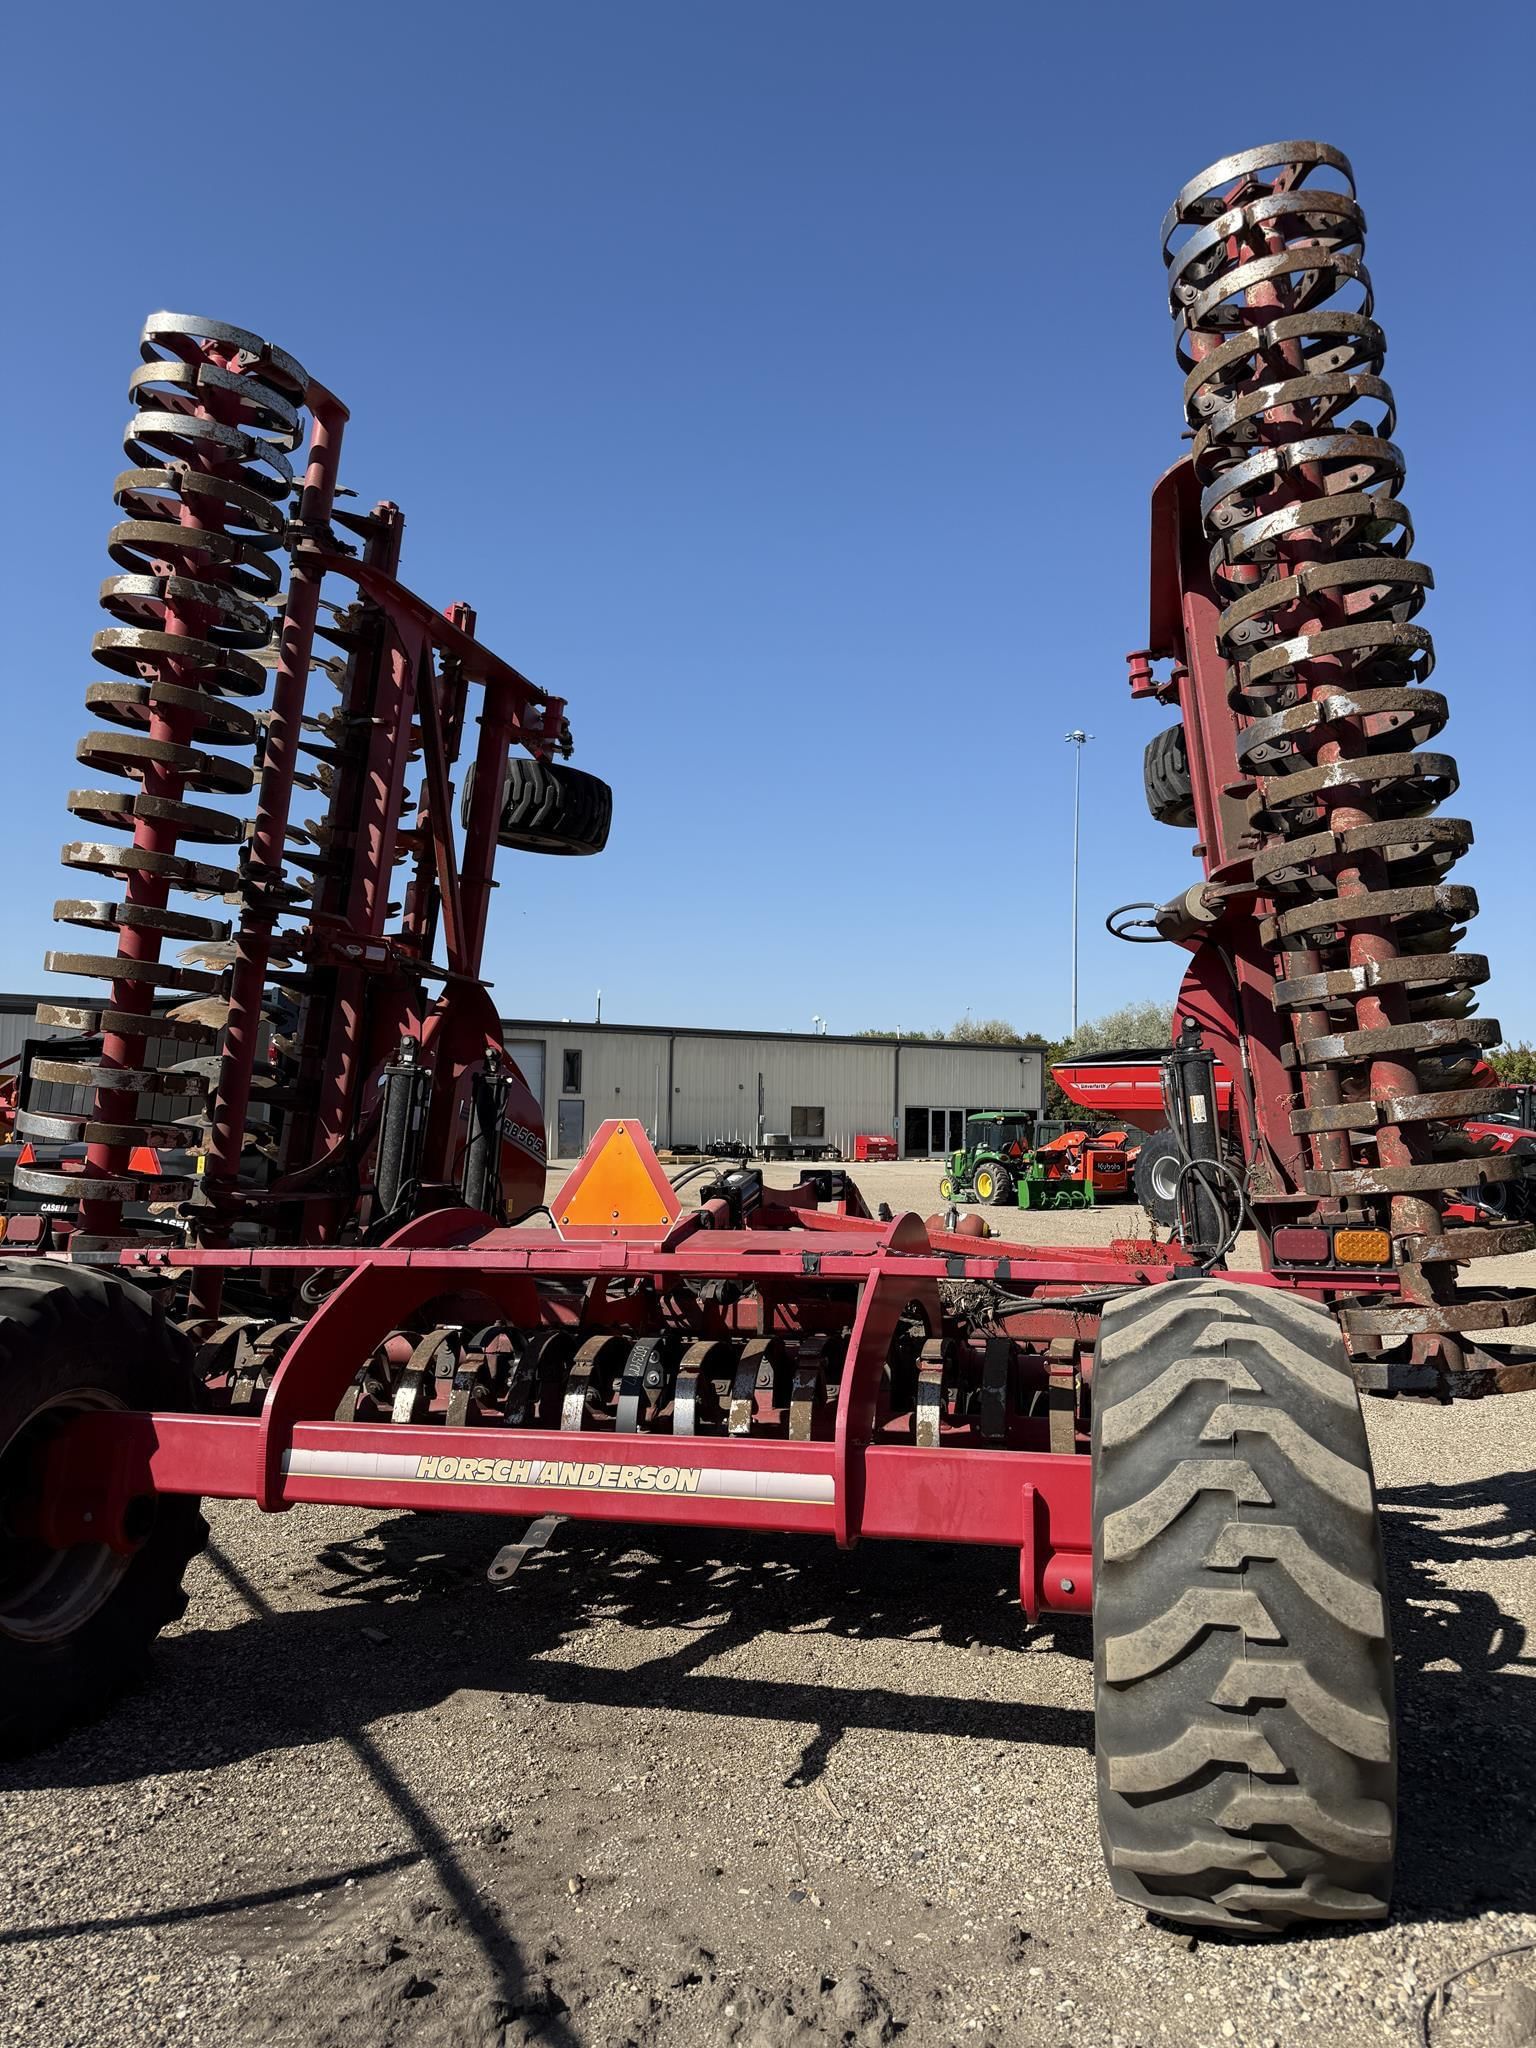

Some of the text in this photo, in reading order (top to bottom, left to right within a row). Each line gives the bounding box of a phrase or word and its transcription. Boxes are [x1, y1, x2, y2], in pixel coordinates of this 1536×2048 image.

[1097, 1162, 1121, 1170] Kubota
[416, 1456, 701, 1493] HORSCH ANDERSON
